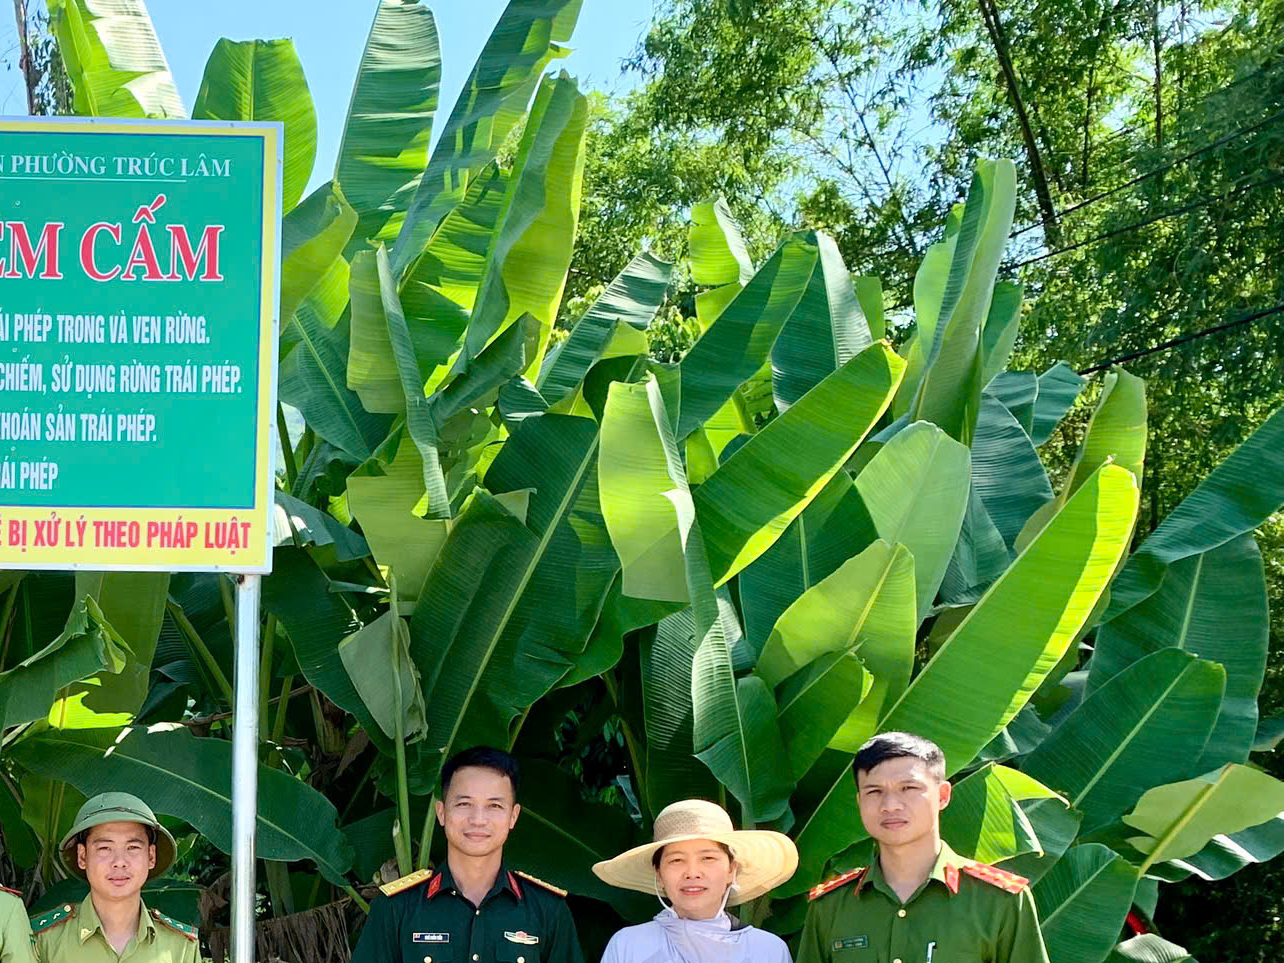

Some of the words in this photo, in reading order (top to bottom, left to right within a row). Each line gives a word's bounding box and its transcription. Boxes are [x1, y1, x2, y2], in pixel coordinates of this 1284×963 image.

[10, 150, 106, 175] PHƯỜNG
[113, 152, 174, 176] TRÚC
[180, 153, 231, 177] LÂM
[79, 193, 225, 282] CẤM
[14, 308, 53, 342] PHÉP
[57, 314, 105, 343] TRONG
[109, 310, 128, 344] VÀ
[132, 315, 161, 344] VEN
[166, 310, 210, 344] RỪNG.
[51, 354, 73, 392] SỬ
[75, 364, 115, 399] DỤNG
[120, 359, 161, 393] RỪNG
[165, 359, 197, 393] TRÁI
[201, 359, 242, 393] PHÉP.
[45, 404, 76, 441] SẢN
[80, 407, 113, 441] TRÁI
[116, 408, 157, 442] PHÉP.
[20, 456, 59, 490] PHÉP
[8, 520, 27, 552] BỊ
[33, 511, 61, 547] XỬ
[65, 515, 87, 547] LÝ
[92, 520, 140, 548] THEO
[147, 515, 198, 549] PHÁP
[204, 516, 251, 555] LUẬT
